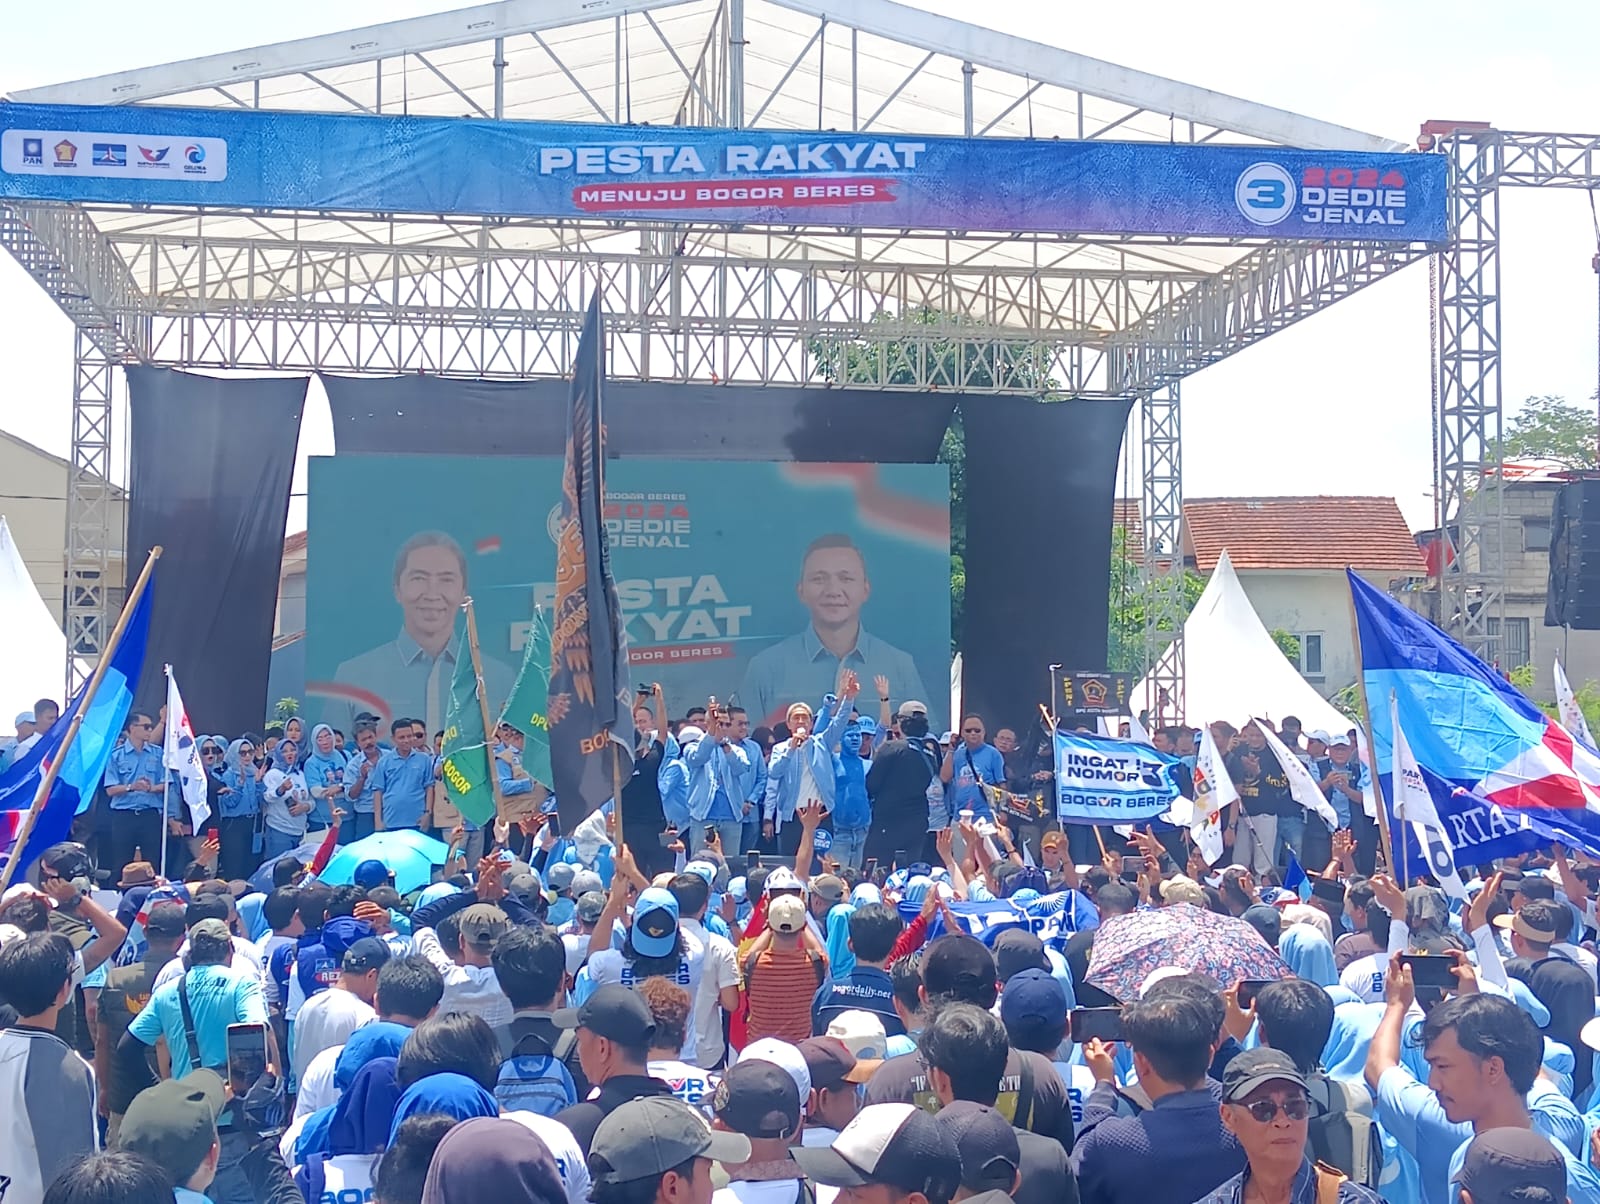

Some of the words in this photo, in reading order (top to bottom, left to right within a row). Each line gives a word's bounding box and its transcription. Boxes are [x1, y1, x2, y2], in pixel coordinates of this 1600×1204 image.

[23, 157, 43, 165] PAN
[540, 144, 706, 175] PESTA
[726, 142, 927, 173] RAKYAT
[1302, 167, 1405, 188] 2024
[580, 189, 687, 203] MENUJU
[696, 186, 784, 200] BOGOR
[793, 184, 876, 199] BERES
[1246, 179, 1286, 209] 3
[1302, 187, 1407, 208] DEDIE
[1302, 207, 1406, 225] JENAL
[603, 502, 690, 519] 2024
[604, 519, 691, 534] DEDIE
[607, 535, 691, 549] JENAL
[533, 574, 729, 614] PSTA
[631, 651, 664, 661] GOR
[670, 647, 723, 658] BERES
[1068, 753, 1129, 770] INGAT
[1067, 766, 1140, 782] NOMOR
[1061, 793, 1122, 808] BOGOR
[1031, 911, 1076, 935] PAN
